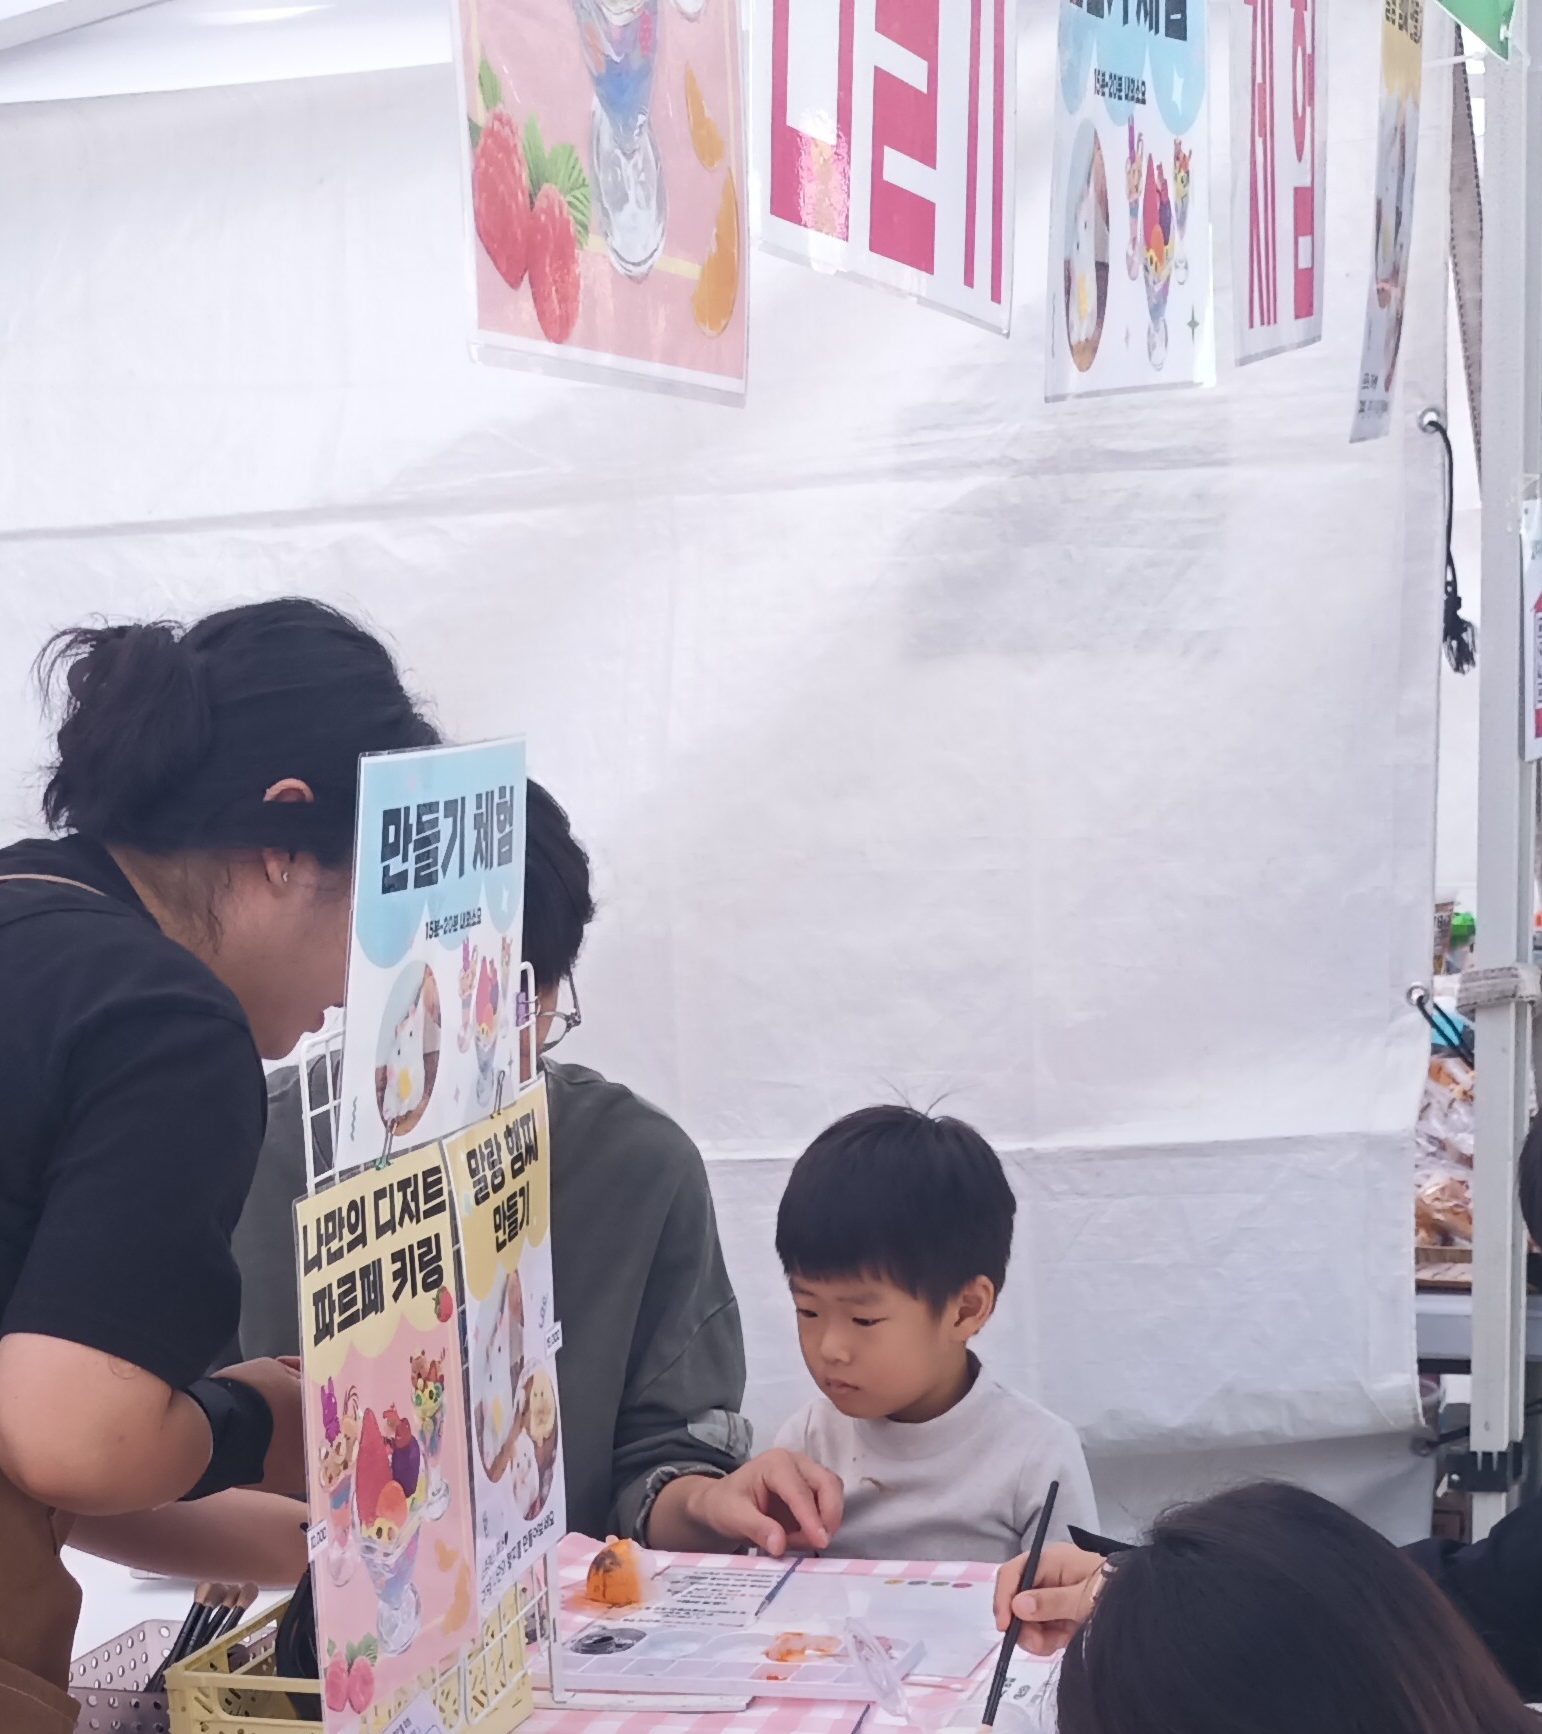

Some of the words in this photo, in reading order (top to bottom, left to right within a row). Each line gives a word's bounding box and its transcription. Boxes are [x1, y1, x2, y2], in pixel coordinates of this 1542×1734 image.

[380, 796, 466, 895] 만들기
[473, 785, 514, 873] 체험
[466, 1132, 506, 1207] 말랑
[506, 1108, 539, 1180] 햄찌
[303, 1196, 368, 1277] 나만의
[373, 1164, 447, 1243] 디저트
[493, 1180, 530, 1253] 만들기
[312, 1257, 385, 1347] 파르페
[391, 1232, 444, 1303] 키링
